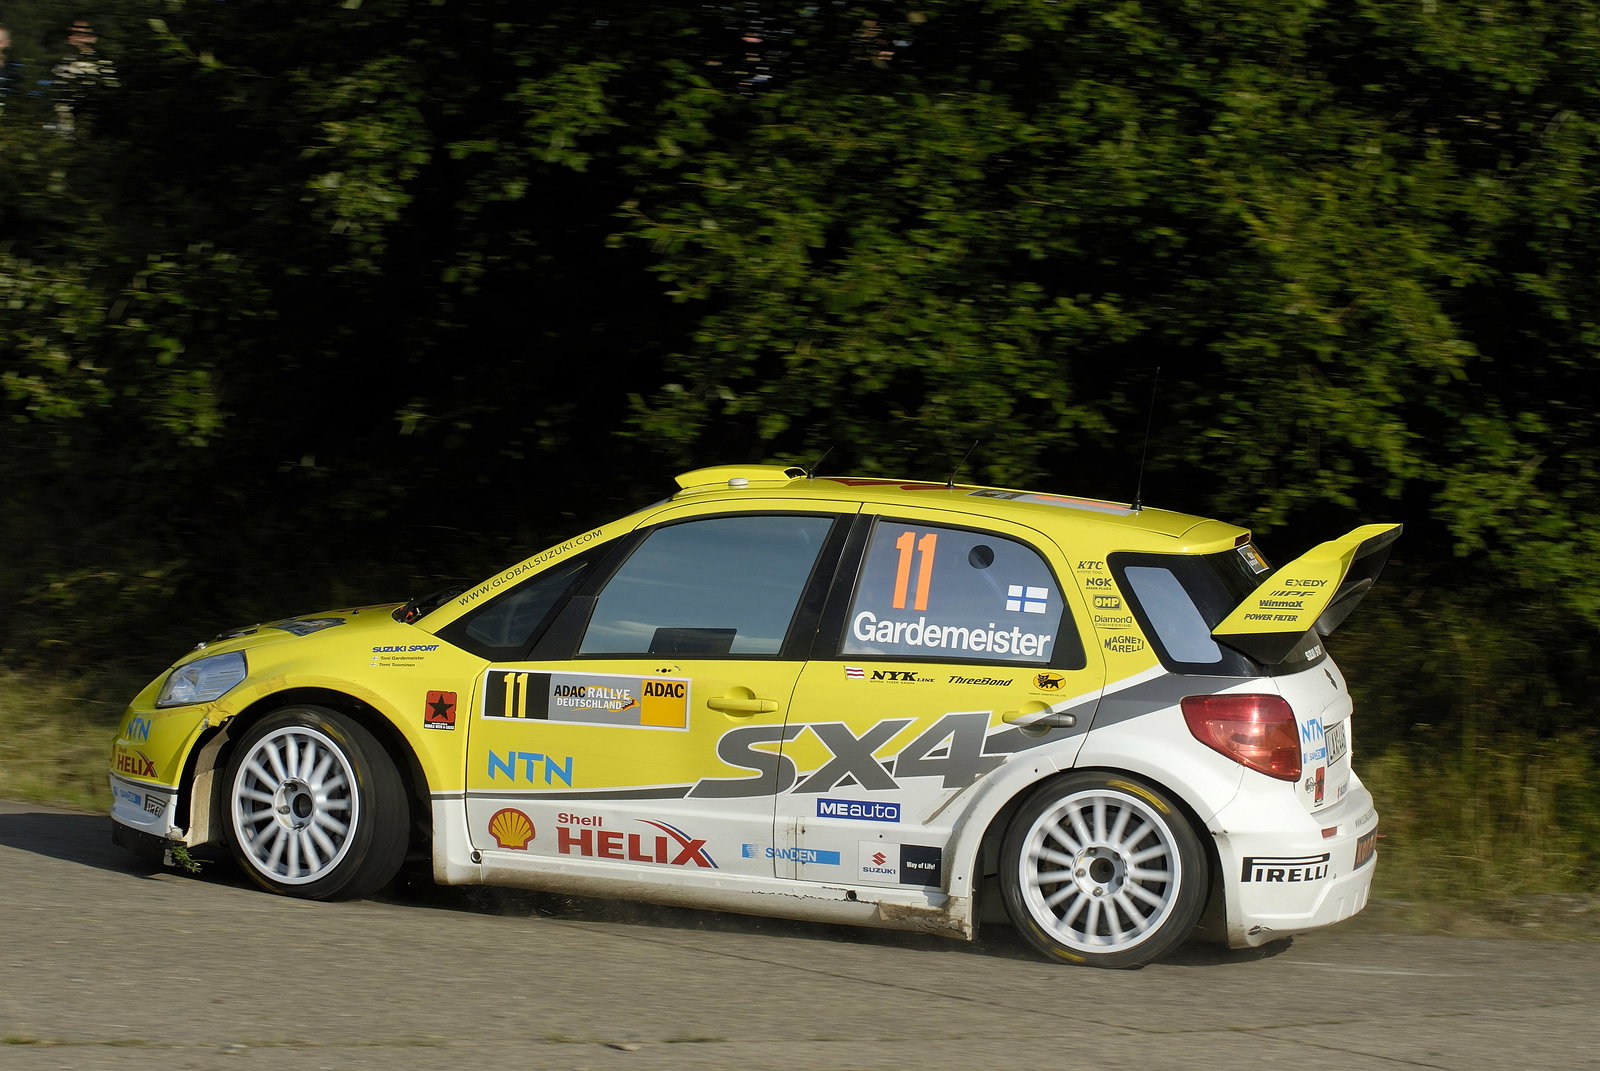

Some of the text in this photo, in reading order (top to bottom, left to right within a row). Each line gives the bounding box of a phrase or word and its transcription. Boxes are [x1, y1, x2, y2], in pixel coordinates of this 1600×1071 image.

[458, 528, 604, 606] WWW.GLOBALSUZUKI.COM
[892, 531, 938, 611] 11
[1077, 560, 1104, 570] KTC
[1086, 578, 1112, 587] NGK
[1285, 579, 1328, 587] EXEDY
[1094, 597, 1120, 608] OMP
[1244, 613, 1299, 622] POWER FILTER
[853, 611, 1051, 657] Gardemeister
[1104, 636, 1144, 649] MAGNETI
[871, 671, 918, 681] NYK
[948, 675, 1014, 687] ThreeBond
[503, 673, 529, 718] 11
[554, 684, 631, 701] ADAC RALLYE
[643, 682, 685, 698] ADAC
[556, 697, 622, 711] DEUTSCHLAND
[125, 717, 152, 742] NTN
[1301, 717, 1324, 744] NTN
[685, 710, 1010, 799] SX4
[117, 753, 158, 778] HELIX
[487, 749, 574, 788] NTN
[556, 812, 603, 827] Shell
[555, 818, 720, 869] HELIX
[765, 846, 818, 863] SANDEN
[1241, 853, 1330, 883] PIRELLI
